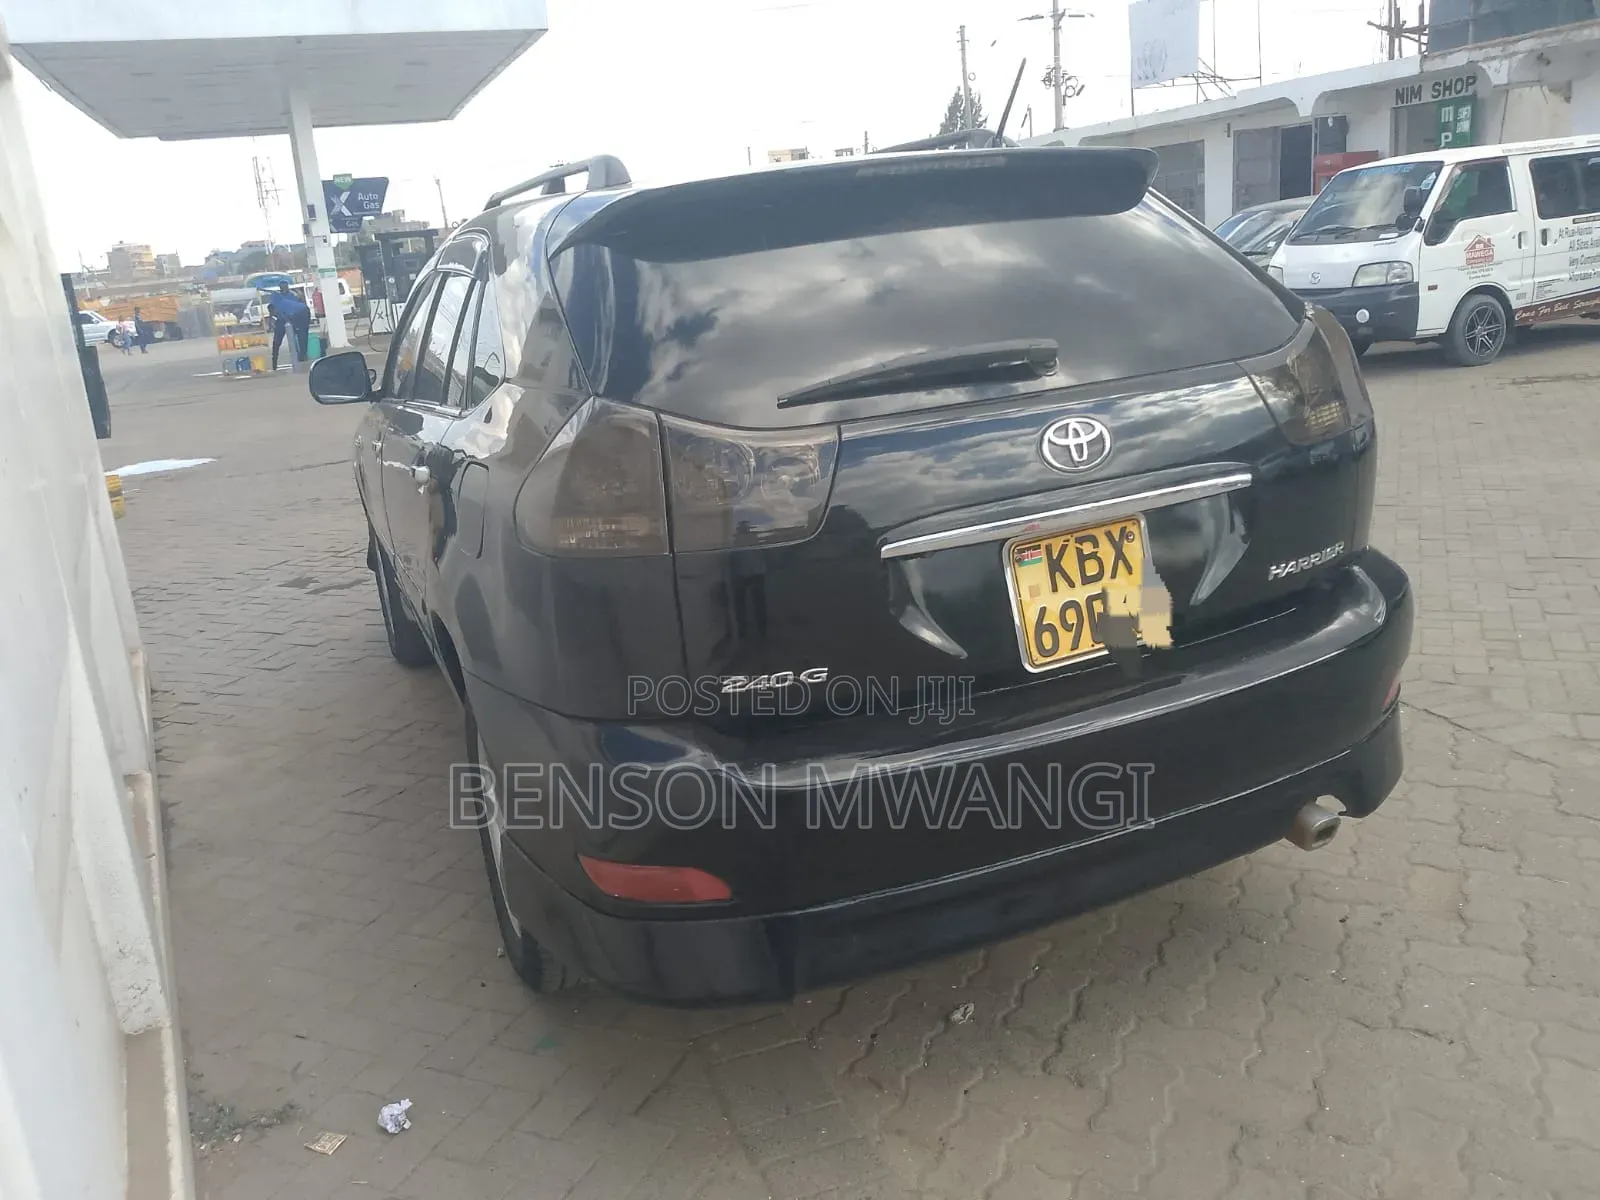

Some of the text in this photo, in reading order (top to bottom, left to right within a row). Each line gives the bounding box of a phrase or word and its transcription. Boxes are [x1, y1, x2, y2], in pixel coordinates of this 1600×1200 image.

[1395, 75, 1477, 106] NIM SHOP
[358, 192, 379, 201] Auto
[363, 201, 380, 210] Gas
[1044, 525, 1133, 593] KBX
[1267, 541, 1345, 581] HARRIER
[721, 667, 829, 694] 240 G
